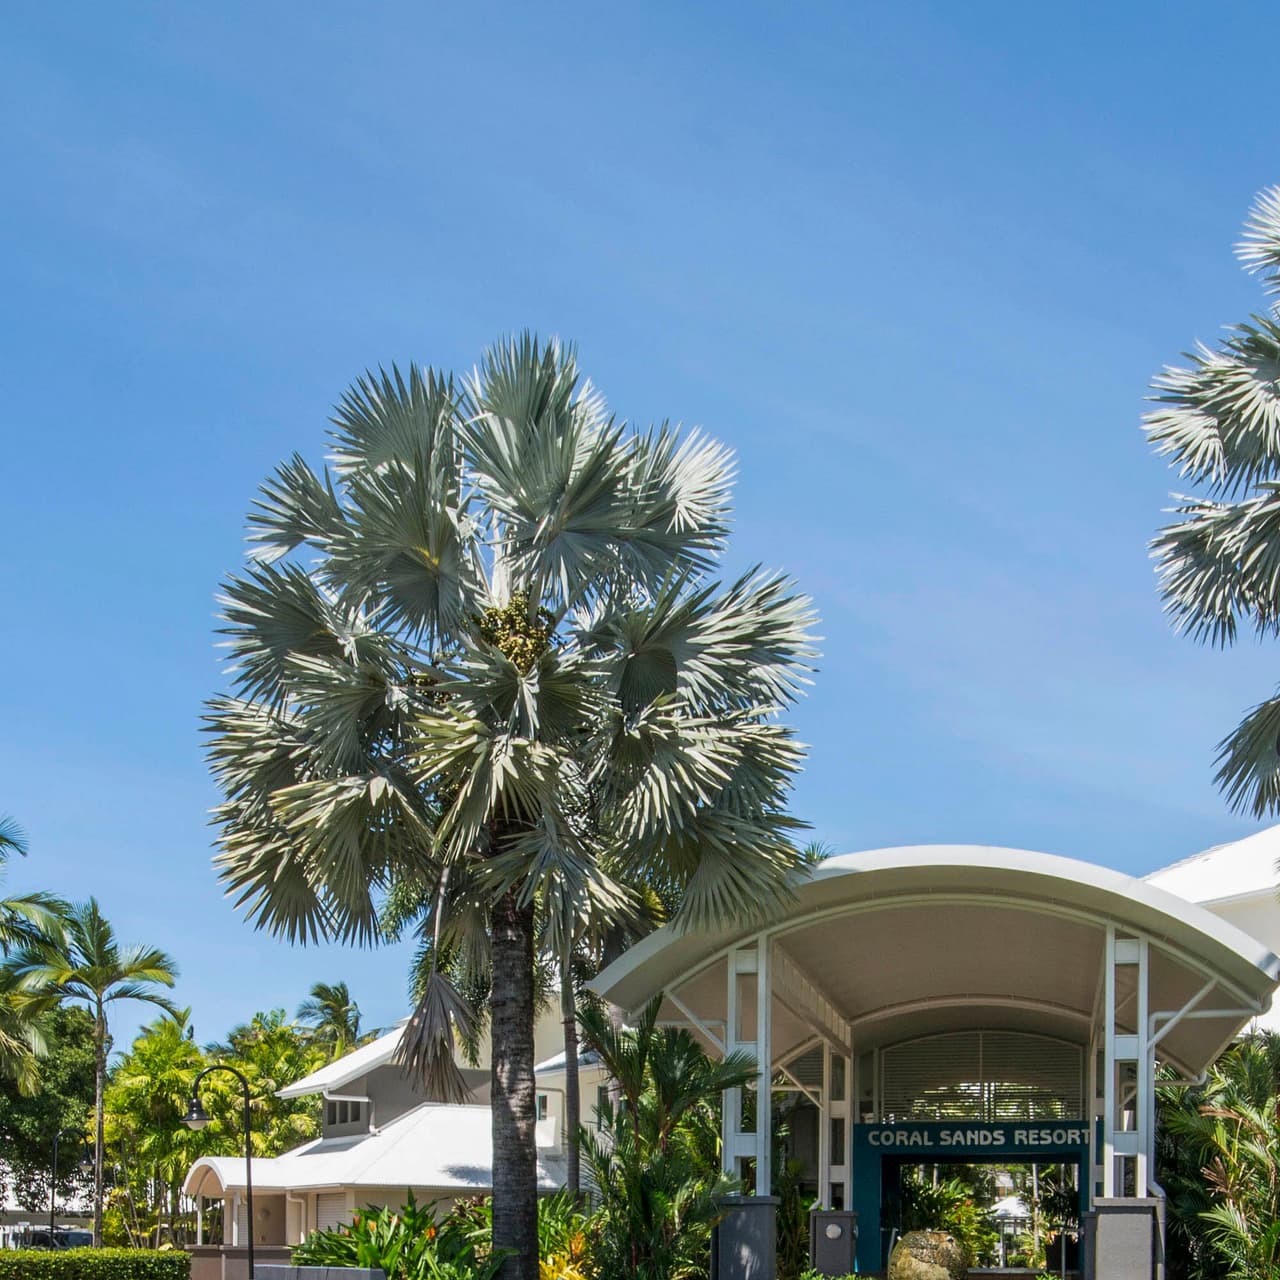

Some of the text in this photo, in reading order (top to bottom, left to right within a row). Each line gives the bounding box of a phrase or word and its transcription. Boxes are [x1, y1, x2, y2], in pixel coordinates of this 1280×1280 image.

[868, 1129, 1090, 1146] CORAL SANDS RESORT
